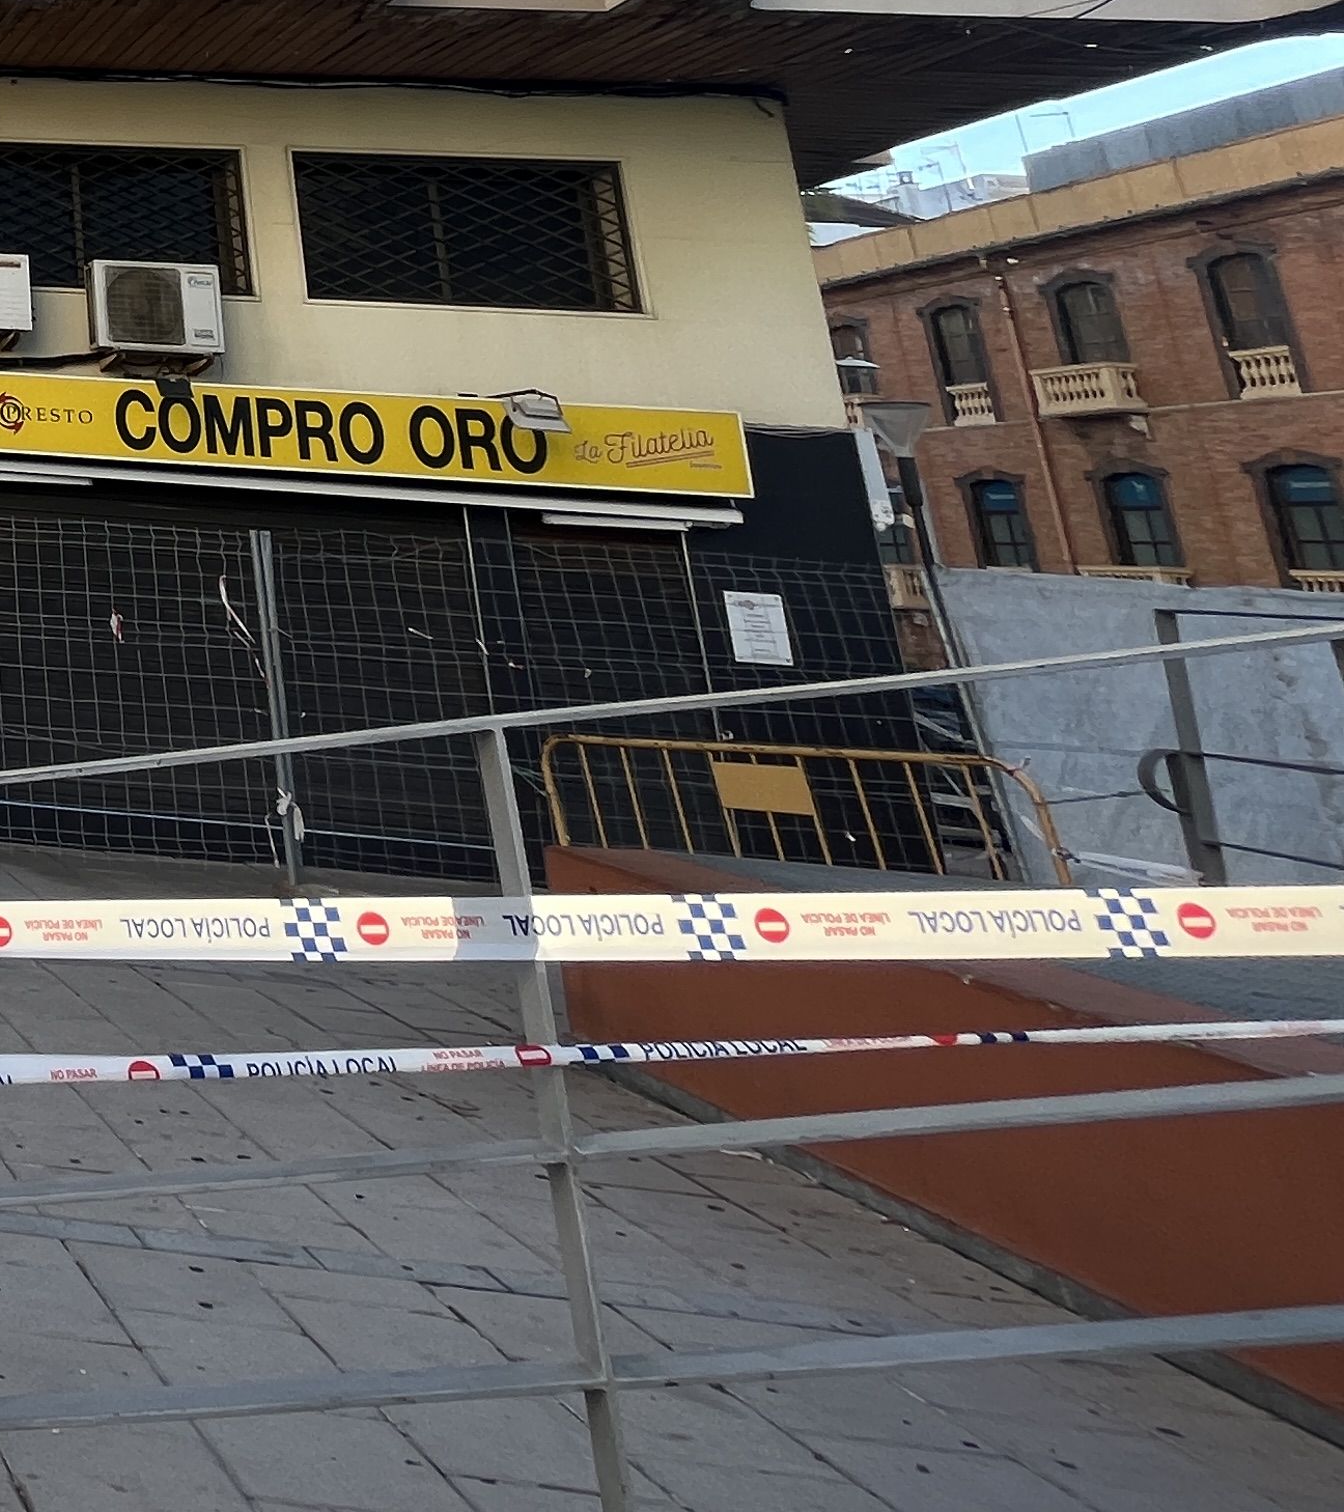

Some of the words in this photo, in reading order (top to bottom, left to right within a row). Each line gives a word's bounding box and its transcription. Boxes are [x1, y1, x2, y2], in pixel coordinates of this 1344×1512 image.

[115, 389, 385, 465] COMPRO
[409, 405, 548, 474] ORO
[575, 440, 603, 463] La
[604, 428, 713, 463] Filatelia
[120, 918, 186, 938] LOCAL
[191, 917, 271, 943] POLICÍA
[502, 914, 575, 936] LOCAL
[577, 913, 664, 941] POLICÍA
[908, 910, 988, 933] LOCAL
[990, 909, 1082, 938] POLICÍA
[43, 932, 71, 941] PASAR
[73, 932, 88, 941] NO
[433, 1051, 448, 1059] NO
[450, 1049, 484, 1058] PASAR
[50, 1070, 64, 1080] NO
[66, 1068, 98, 1080] PASAR
